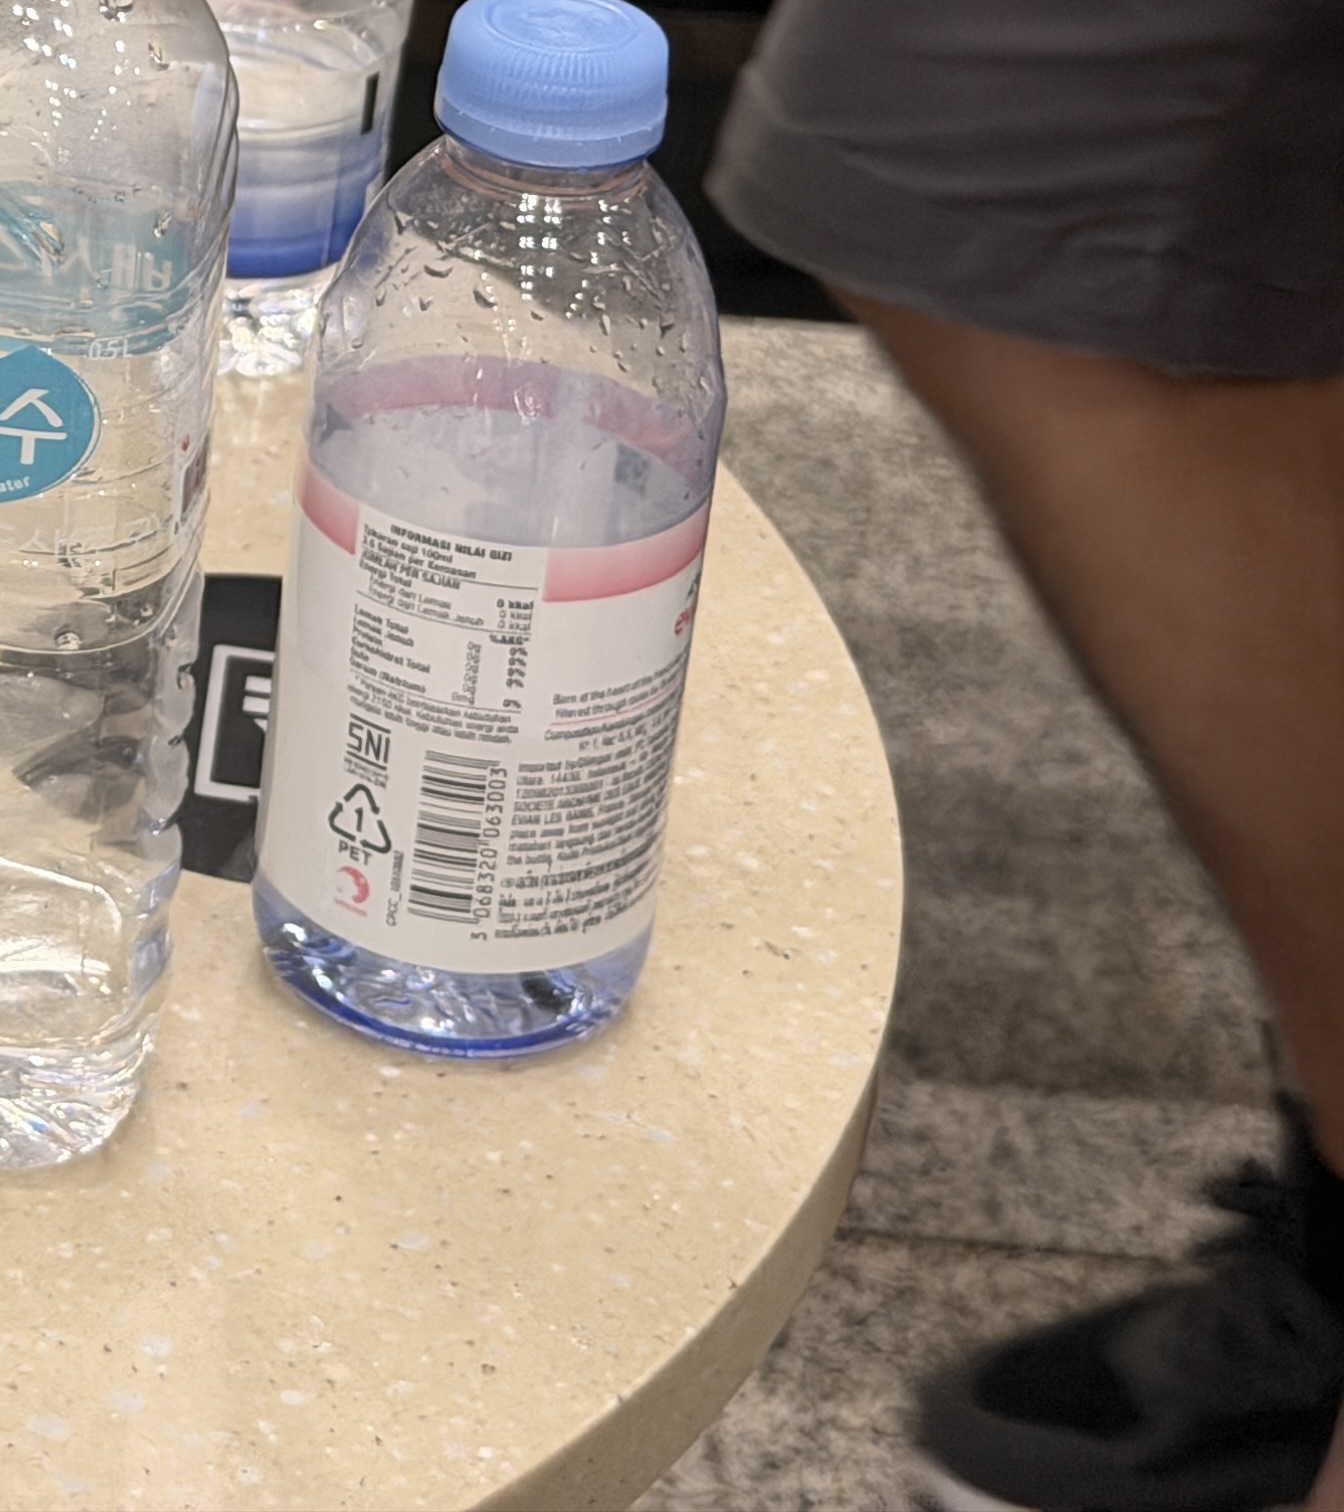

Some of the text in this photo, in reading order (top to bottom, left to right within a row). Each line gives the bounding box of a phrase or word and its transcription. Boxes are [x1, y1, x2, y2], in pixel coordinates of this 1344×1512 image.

[346, 721, 392, 765] SNI
[354, 805, 364, 833] 1
[338, 839, 372, 866] PET
